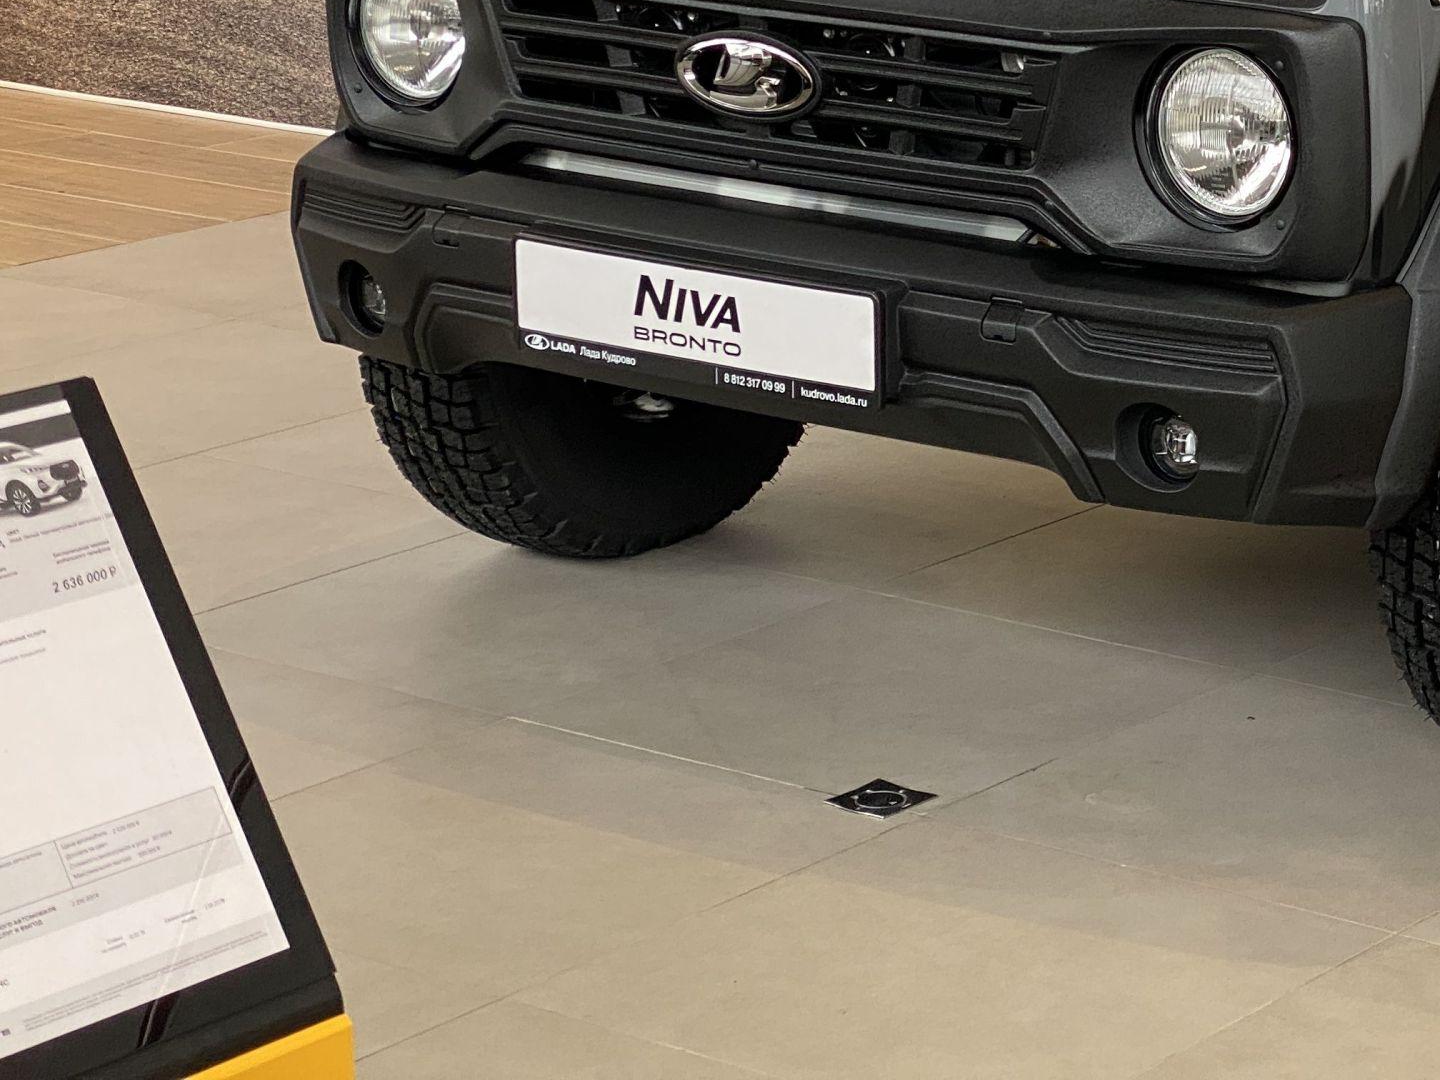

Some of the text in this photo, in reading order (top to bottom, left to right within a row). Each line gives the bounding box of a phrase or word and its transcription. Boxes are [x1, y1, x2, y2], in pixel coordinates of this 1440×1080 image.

[633, 274, 742, 334] NIVA
[550, 340, 576, 354] LADA
[633, 325, 742, 357] BRONTO
[579, 346, 636, 367] Лада Кудрово
[723, 373, 786, 394] 8 812 317 09 99
[800, 387, 868, 408] kudrovo.lada.ru
[52, 581, 60, 594] 2
[62, 575, 84, 591] 636
[86, 568, 108, 584] 000
